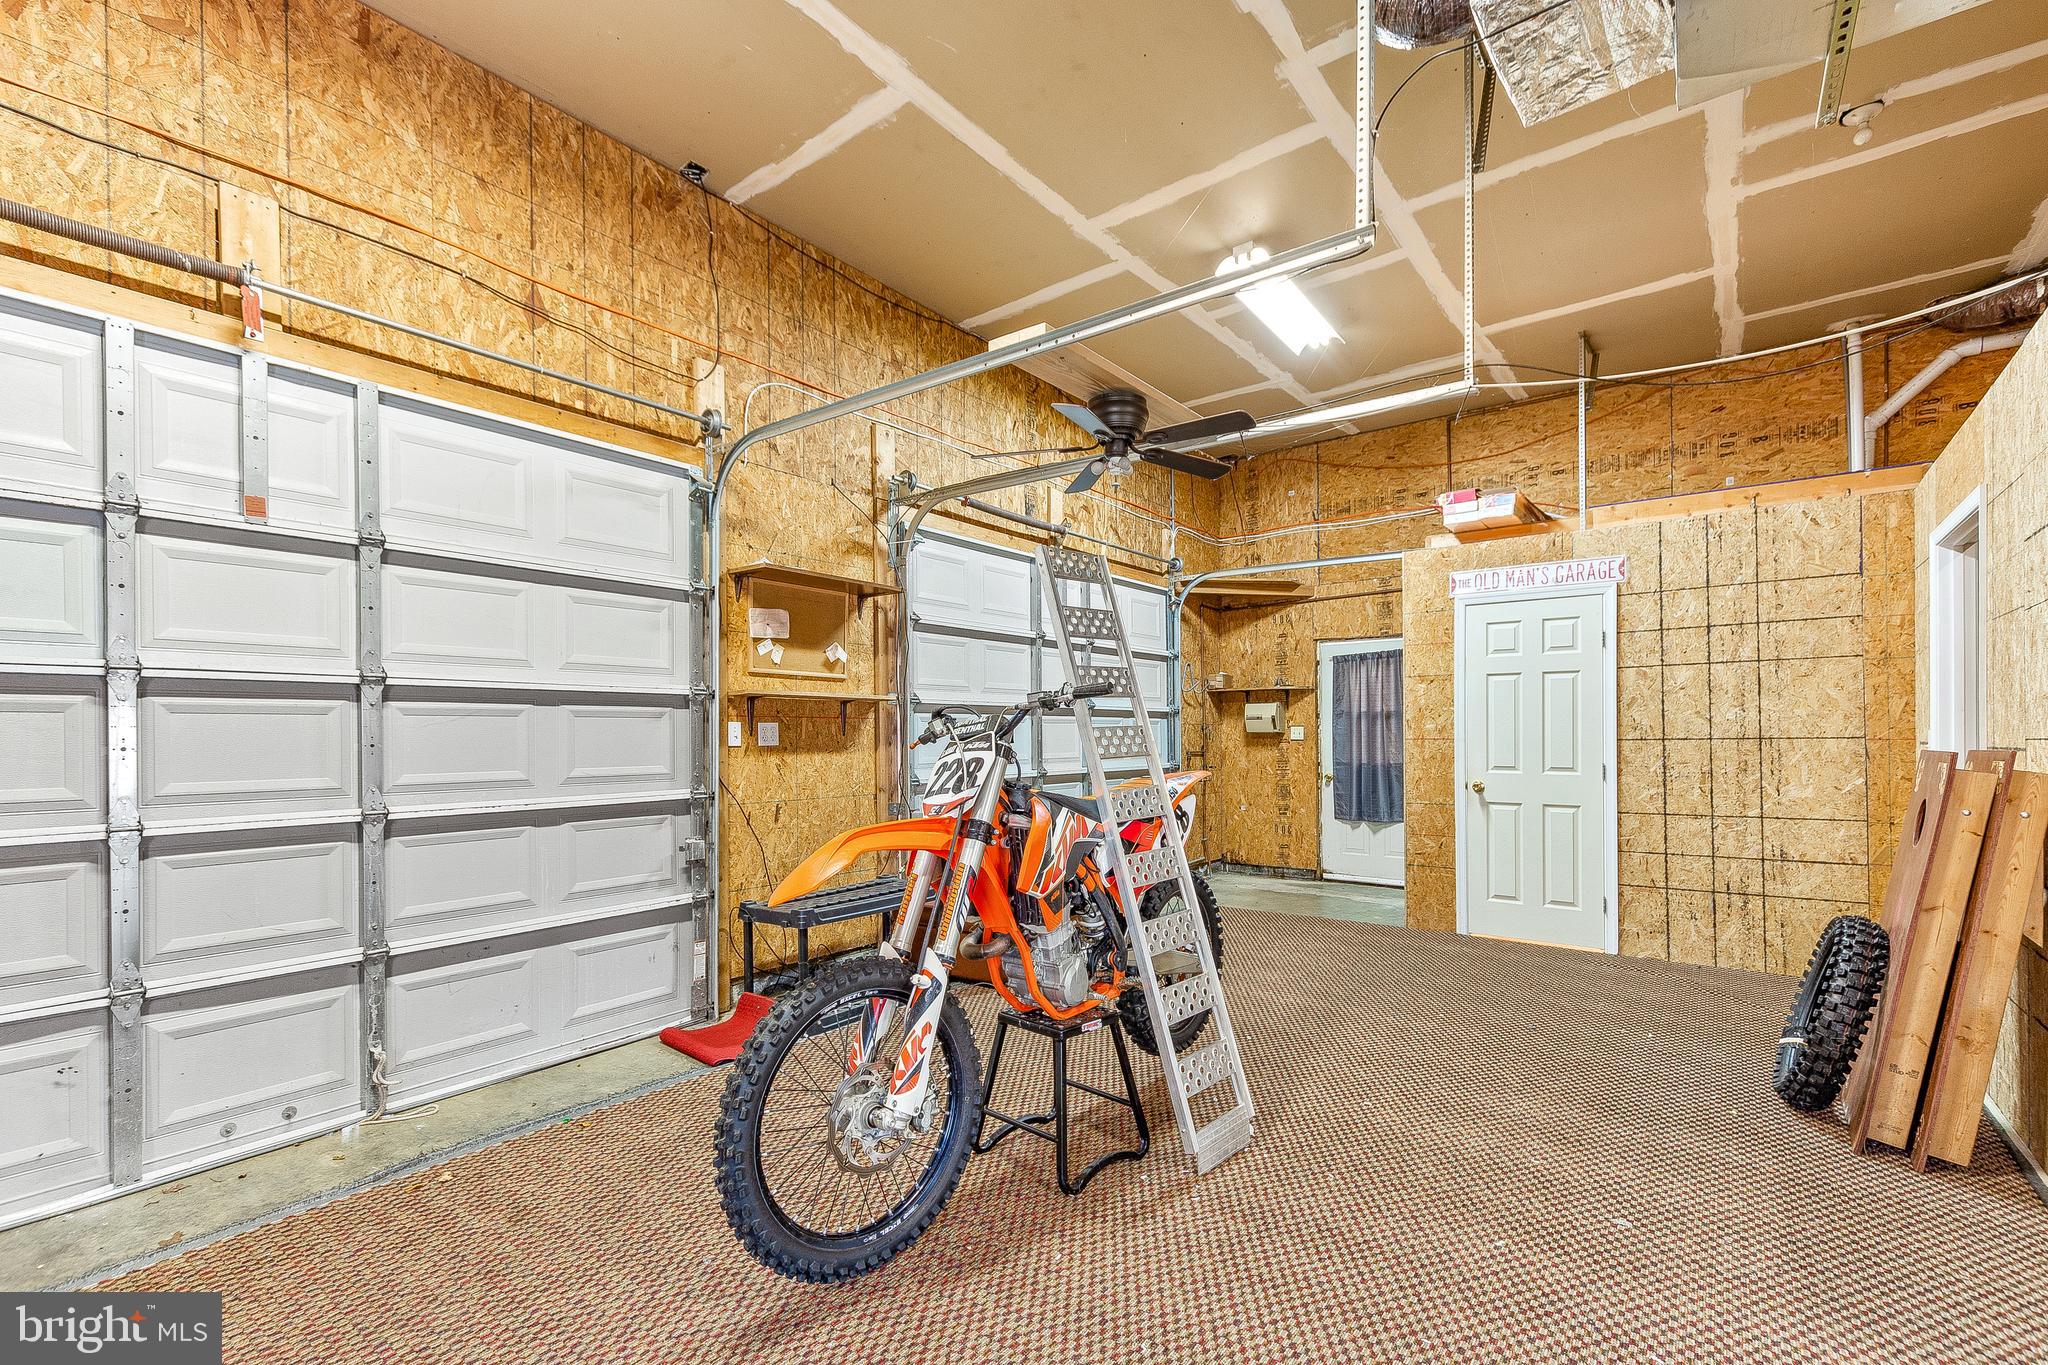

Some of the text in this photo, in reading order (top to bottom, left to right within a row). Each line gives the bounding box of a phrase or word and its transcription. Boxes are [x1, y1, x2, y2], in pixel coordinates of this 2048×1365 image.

[1458, 560, 1617, 591] THE OLD MAN'S GARAGE
[924, 757, 985, 799] 228
